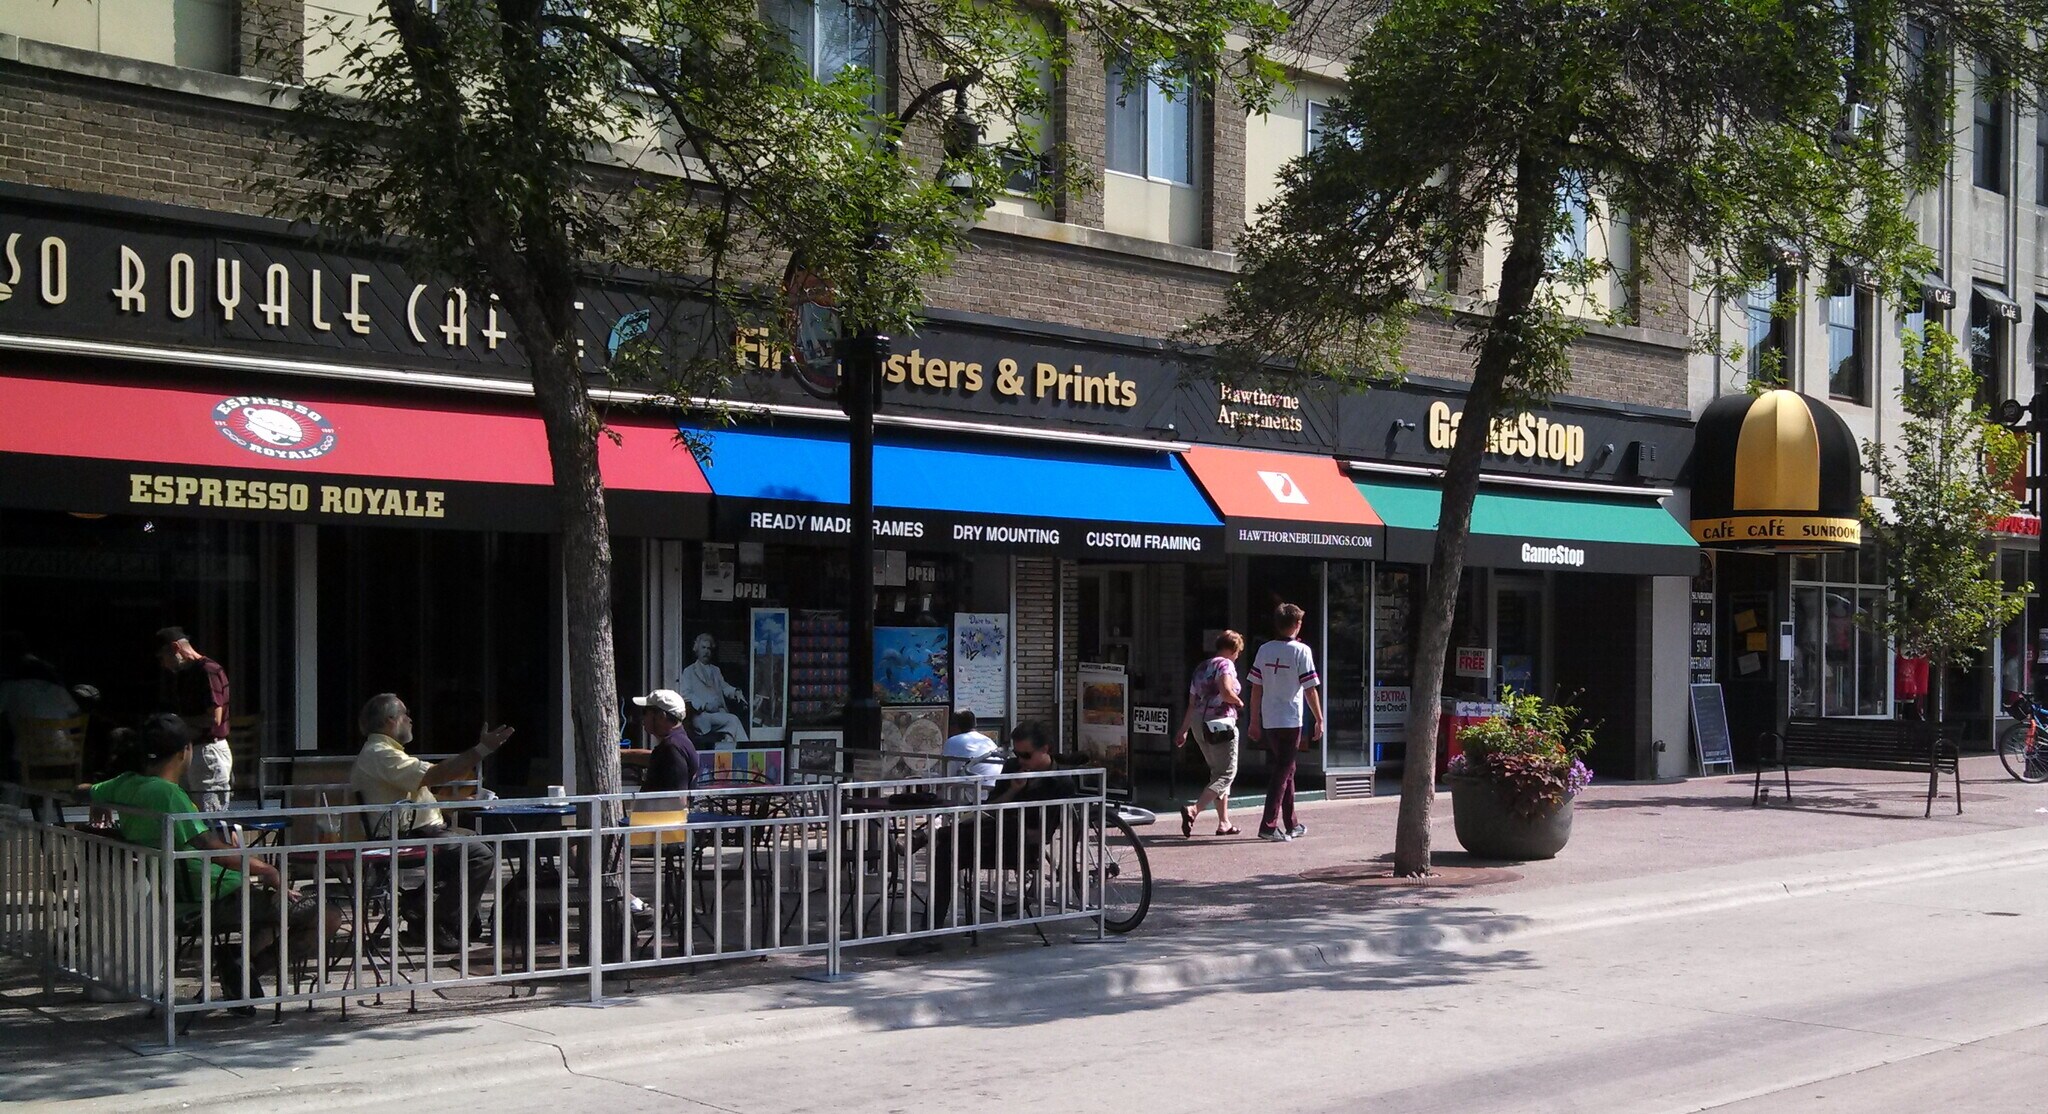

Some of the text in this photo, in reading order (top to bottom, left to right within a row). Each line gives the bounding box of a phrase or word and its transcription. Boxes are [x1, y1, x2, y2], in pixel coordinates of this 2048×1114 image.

[111, 245, 371, 334] ROYALE
[407, 284, 584, 357] CAF
[837, 349, 984, 391] sters
[997, 357, 1026, 397] &
[1036, 362, 1138, 407] Prints
[1220, 382, 1300, 410] Hawthorne
[216, 396, 322, 422] ESPRESSO
[248, 443, 323, 460] ROYALE
[130, 473, 445, 519] ESPRESSO ROYALE
[750, 511, 807, 531] READY
[872, 519, 924, 538] RAMES
[953, 524, 1060, 545] DRY MOUNTING
[1802, 524, 1856, 540] SUNROOM
[1086, 531, 1201, 552] CUSTOM FRAMING
[1238, 529, 1373, 548] HAWTHORNEBUILDINGS.COM
[1521, 543, 1584, 566] GameStop
[908, 566, 936, 582] OPEN
[735, 582, 767, 599] OPEN
[1459, 656, 1485, 671] FREE
[1381, 690, 1407, 702] EXTRA
[1134, 710, 1168, 723] FRAMES
[1387, 703, 1407, 712] Credit
